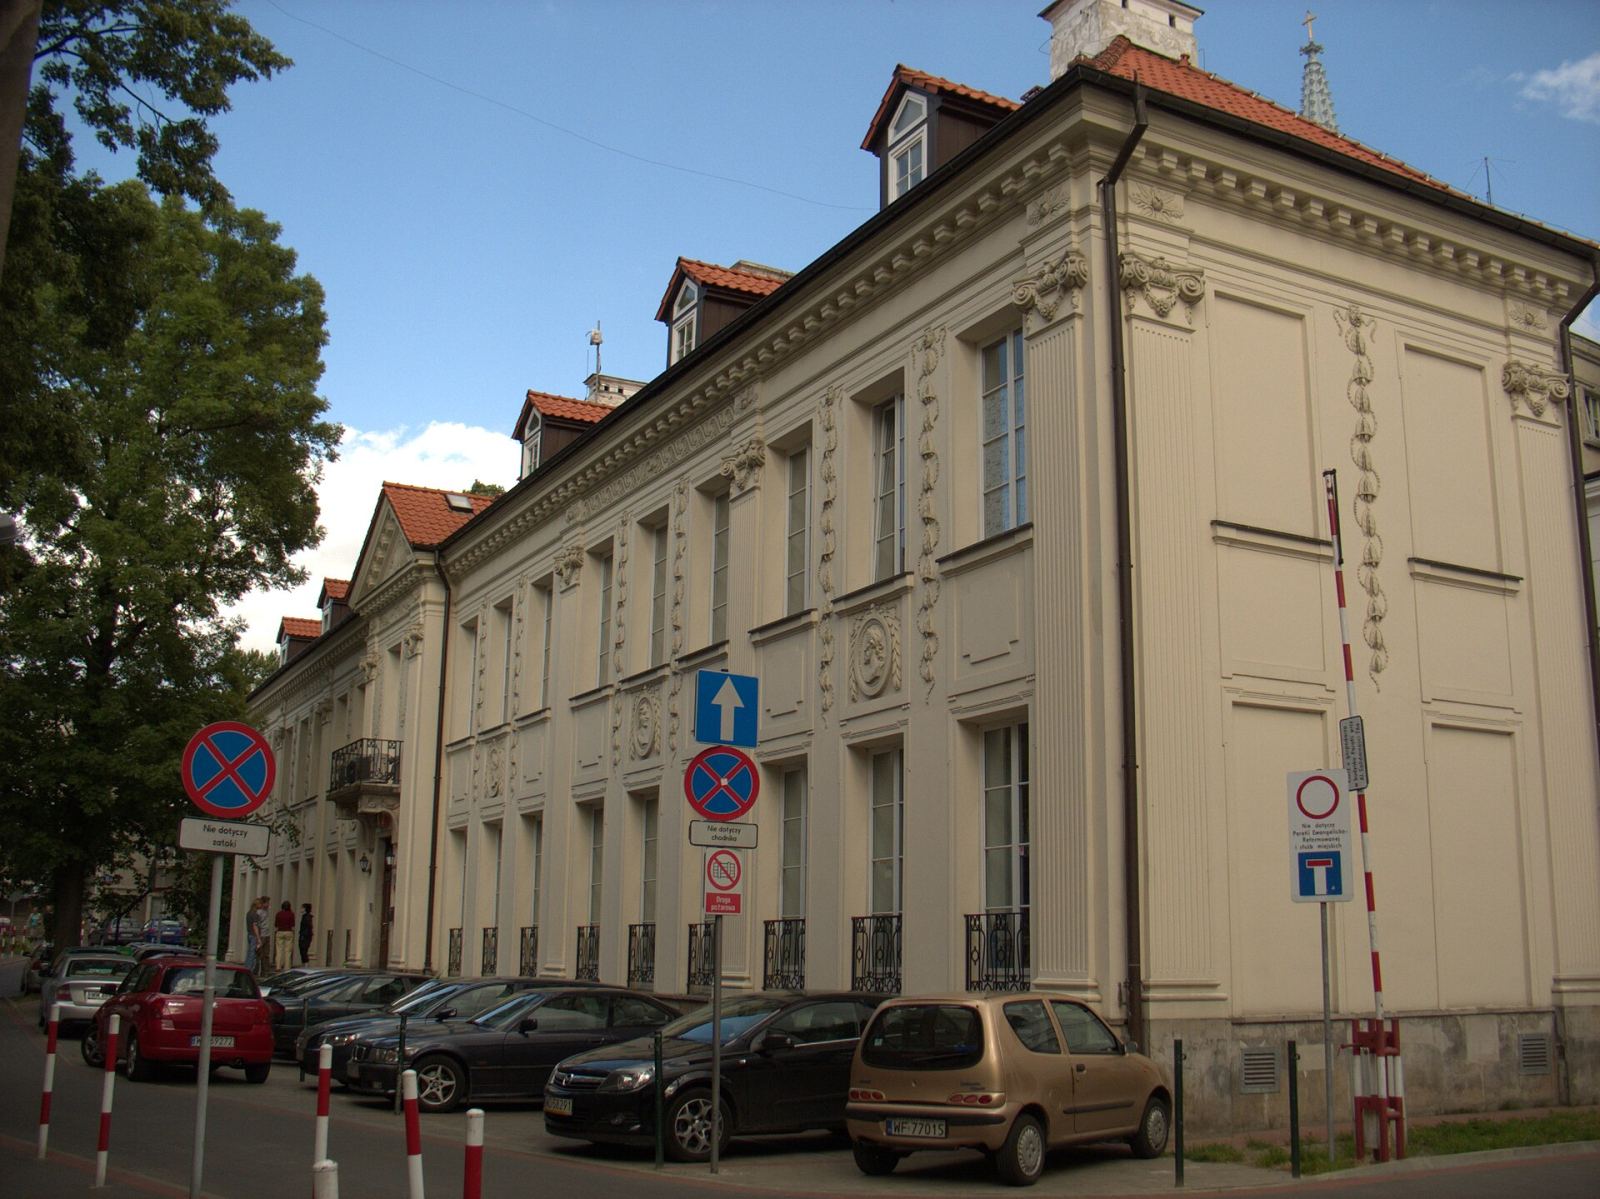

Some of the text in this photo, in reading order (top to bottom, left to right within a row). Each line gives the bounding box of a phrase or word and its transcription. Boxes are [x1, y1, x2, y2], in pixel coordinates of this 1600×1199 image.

[203, 824, 248, 838] Nie dotyczy
[719, 826, 741, 834] dotyczy
[712, 834, 737, 842] chodnika
[212, 839, 237, 848] zatoki
[716, 895, 731, 904] Droga
